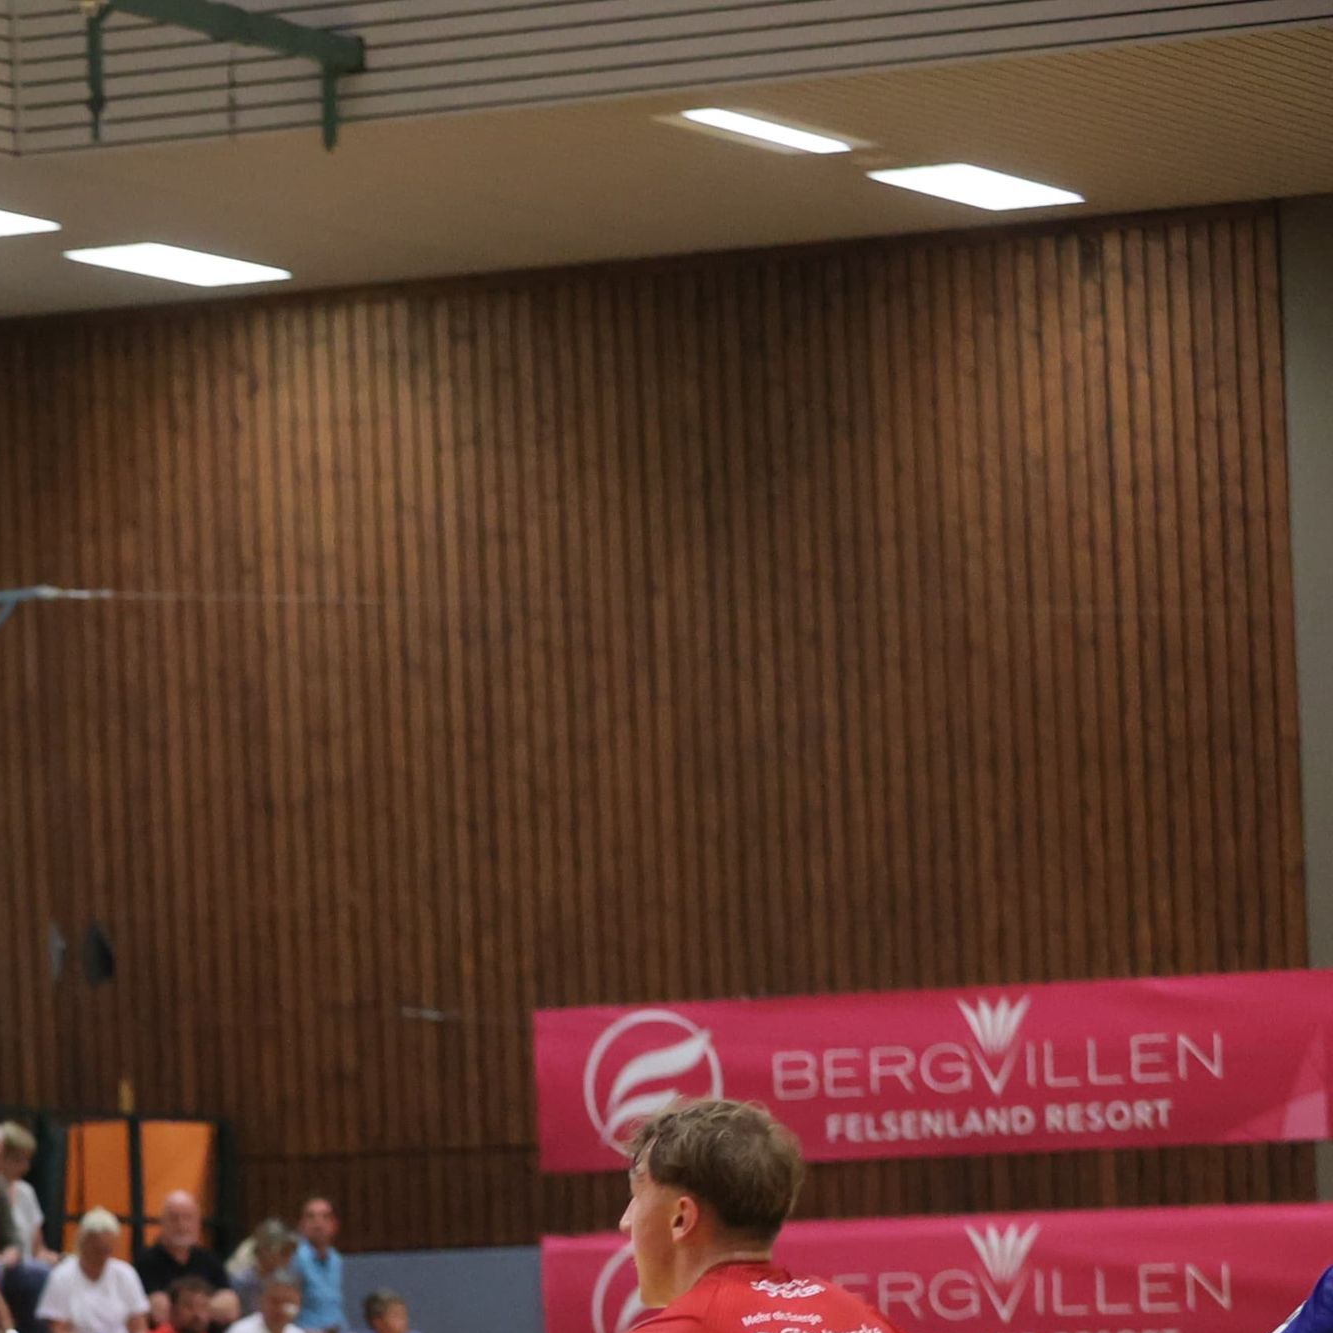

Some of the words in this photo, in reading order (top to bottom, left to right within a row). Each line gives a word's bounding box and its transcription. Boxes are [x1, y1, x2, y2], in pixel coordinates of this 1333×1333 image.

[771, 1031, 1224, 1100] BERGVILLEN
[825, 1104, 1035, 1143] FELSENLAND
[1045, 1098, 1173, 1133] RESORT
[833, 1262, 1231, 1324] RGVILLEN
